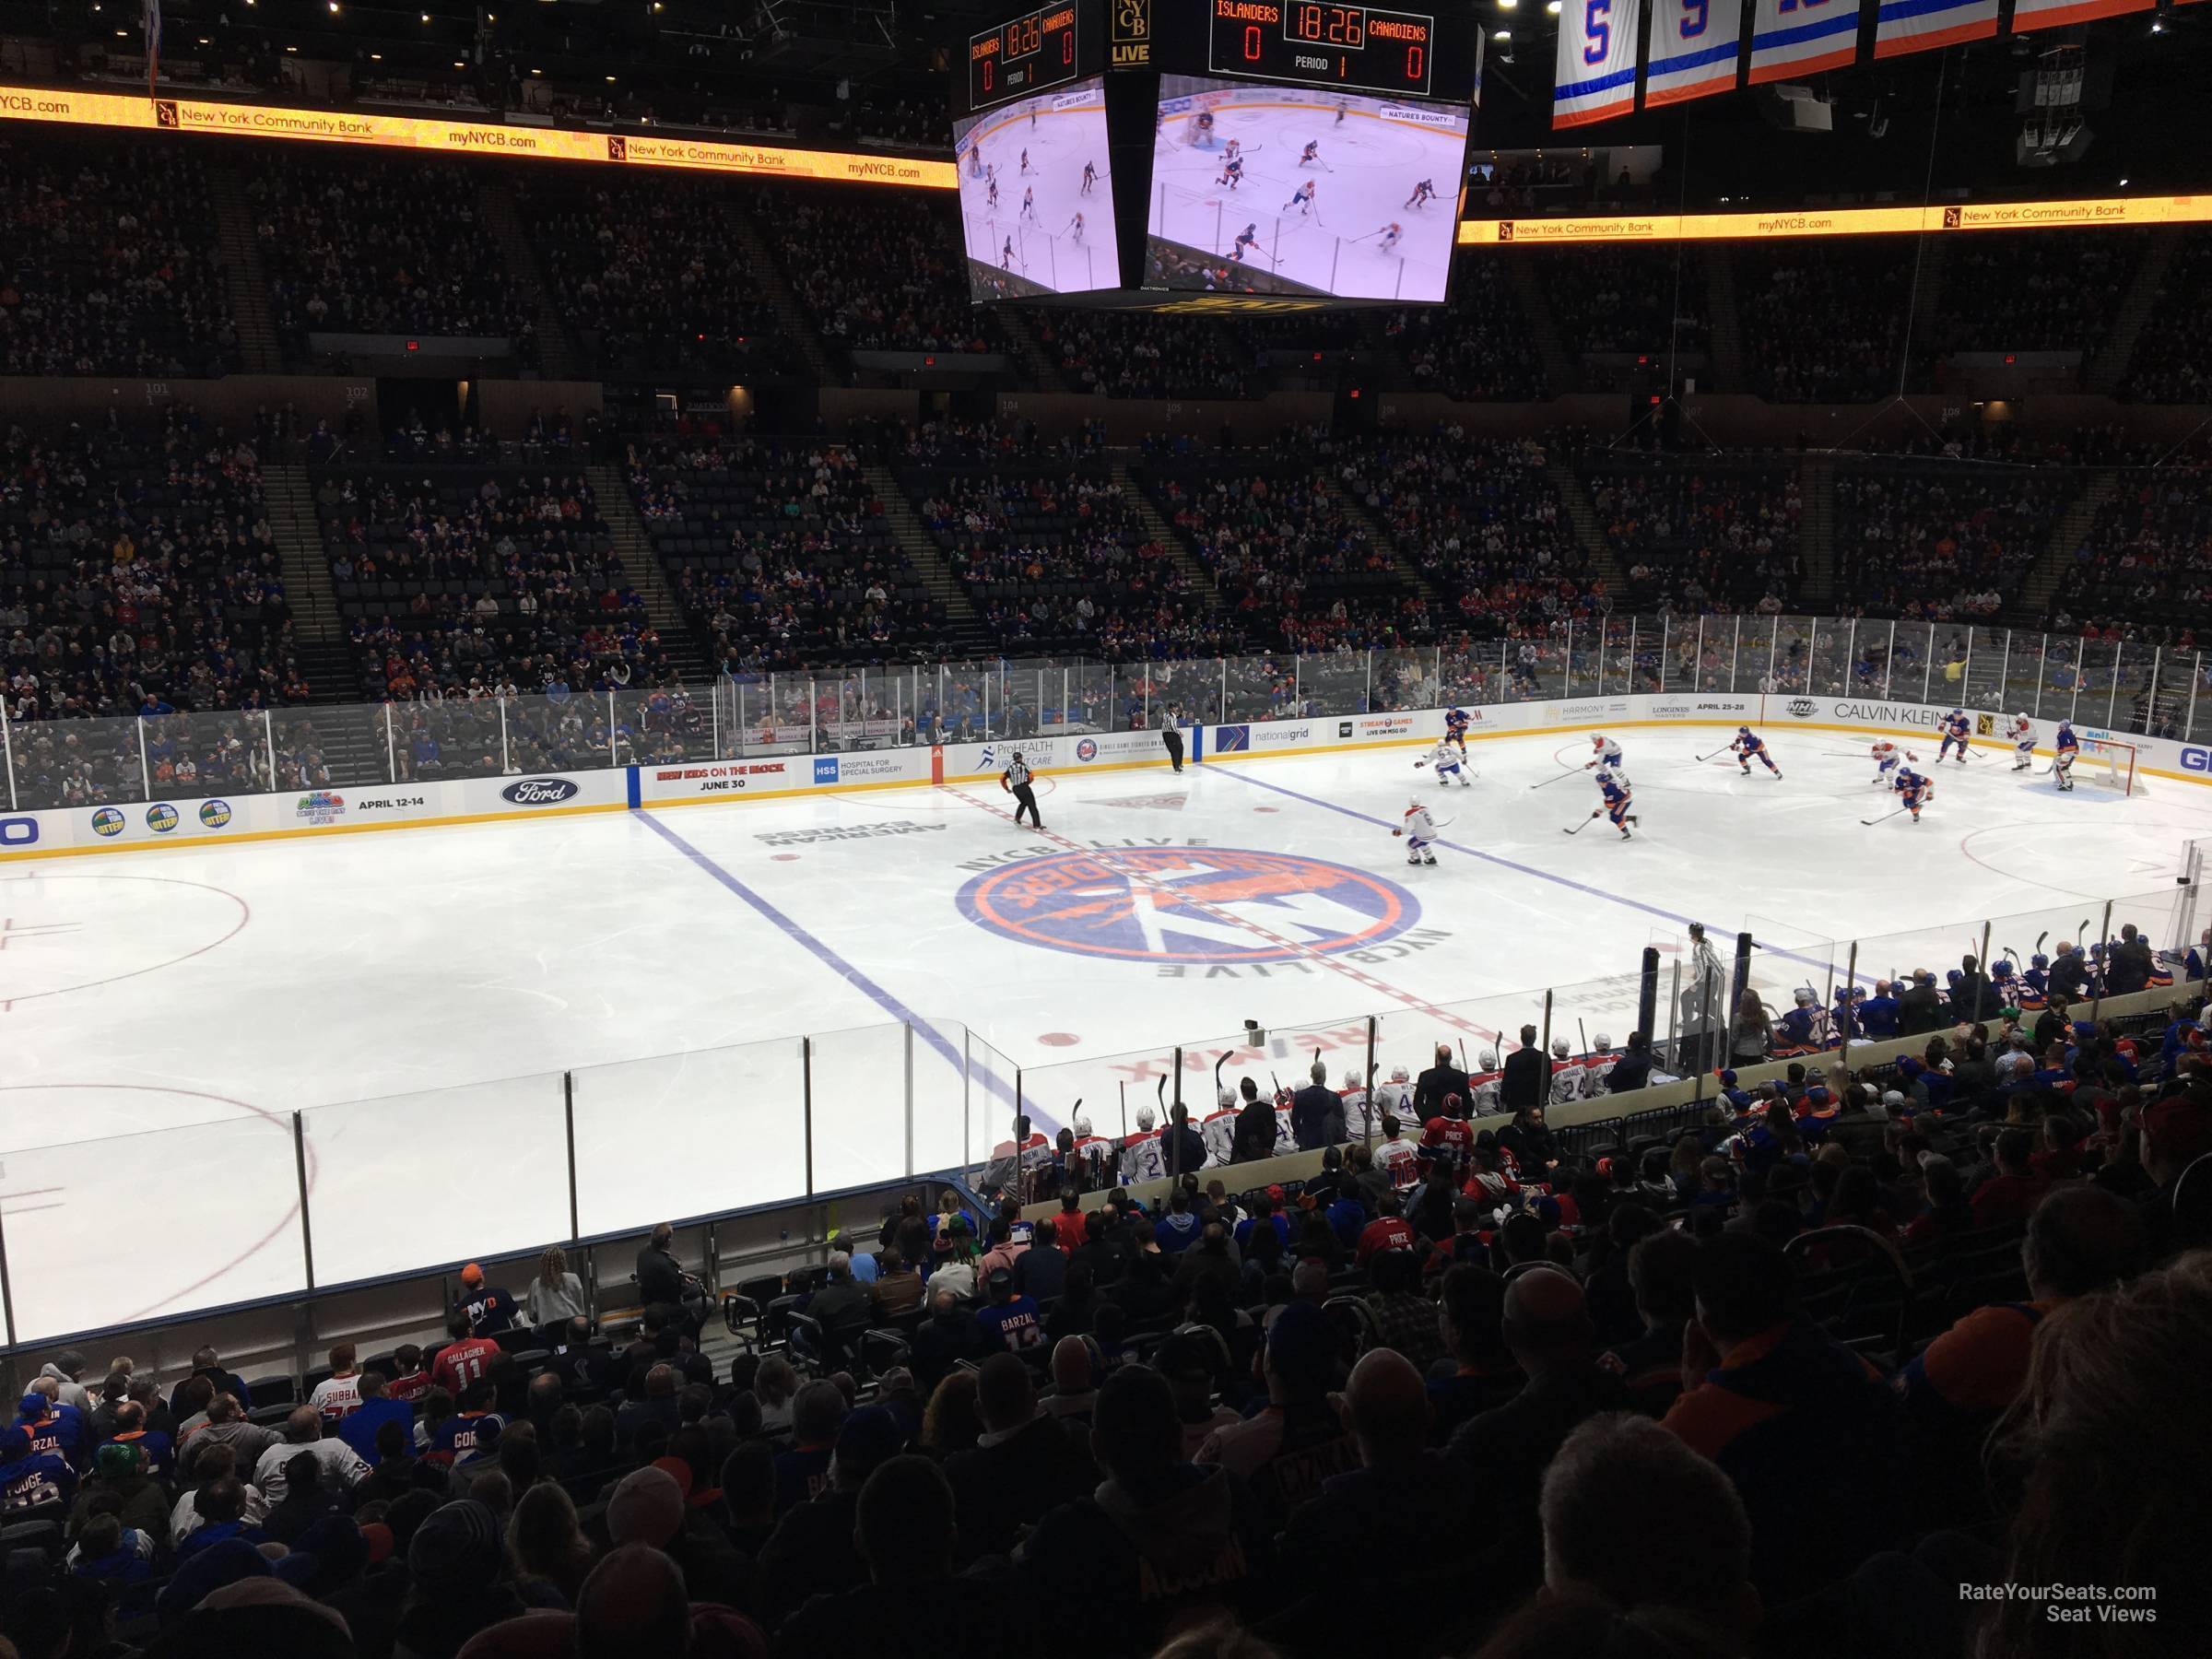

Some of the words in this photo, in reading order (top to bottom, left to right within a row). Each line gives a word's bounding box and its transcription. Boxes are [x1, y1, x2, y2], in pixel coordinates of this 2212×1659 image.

[1217, 0, 1278, 22] ISLANDERS
[1299, 6, 1360, 44] 18:26
[1370, 20, 1426, 41] CANADIENS
[1583, 0, 1610, 66] 5
[1007, 18, 1039, 55] 18:26
[1112, 45, 1149, 62] LIVE
[1295, 56, 1328, 70] PERIOD
[1007, 71, 1023, 86] PERIOD
[182, 109, 215, 121] New
[219, 112, 250, 124] York
[254, 114, 335, 133] Community
[339, 121, 372, 134] Bank
[1388, 112, 1419, 121] NATURE'S
[1422, 114, 1448, 123] BOUNTY
[449, 131, 536, 148] myNYCB.com
[629, 144, 656, 155] New
[660, 146, 685, 158] York
[688, 147, 754, 165] Community
[758, 153, 784, 166] Bank
[848, 162, 920, 179] myNYCB.com
[1963, 210, 1991, 221] New
[1994, 209, 2018, 220] York
[2022, 206, 2093, 221] Community
[2096, 205, 2125, 217] Bank
[1516, 225, 1539, 235] New
[1542, 224, 1563, 234] York
[1566, 223, 1625, 236] Community
[1629, 221, 1653, 232] Bank
[1758, 218, 1832, 233] myNYCB.com
[146, 383, 170, 393] 101
[346, 387, 369, 397] 102
[1563, 705, 1605, 714] HARMONY
[1788, 700, 1818, 715] NHL
[1834, 703, 1897, 722] CALVIN
[1255, 727, 1309, 741] nationalgrid
[997, 741, 1053, 754] ProHEALTH
[841, 761, 874, 770] HOSPITAL
[1031, 756, 1052, 766] CARE
[656, 771, 682, 782] NEW
[684, 769, 708, 780] KIDS
[711, 768, 725, 777] ON
[729, 766, 747, 776] THE
[749, 763, 786, 775] BLOCK
[817, 766, 836, 776] HSS
[841, 768, 870, 776] SPECIAL
[870, 765, 902, 775] SURGERY
[514, 781, 566, 803] Ford
[700, 781, 729, 791] JUNE
[731, 780, 745, 789] 30
[359, 800, 393, 810] APRIL
[395, 796, 424, 807] 12-14
[752, 820, 915, 841] EXPRESS
[764, 823, 947, 846] AMERICAN
[955, 845, 1057, 872] NYCB
[1089, 837, 1208, 849] LIVE
[1345, 925, 1453, 964] NYCB
[1158, 963, 1313, 979] LIVE
[1445, 1130, 1464, 1142] PRICE
[1022, 1148, 1039, 1161] NIEMI
[1001, 1312, 1034, 1331] BARZAL
[447, 1347, 486, 1364] GALLAGHER
[455, 1359, 481, 1391] 11
[31, 1436, 60, 1452] RZAL
